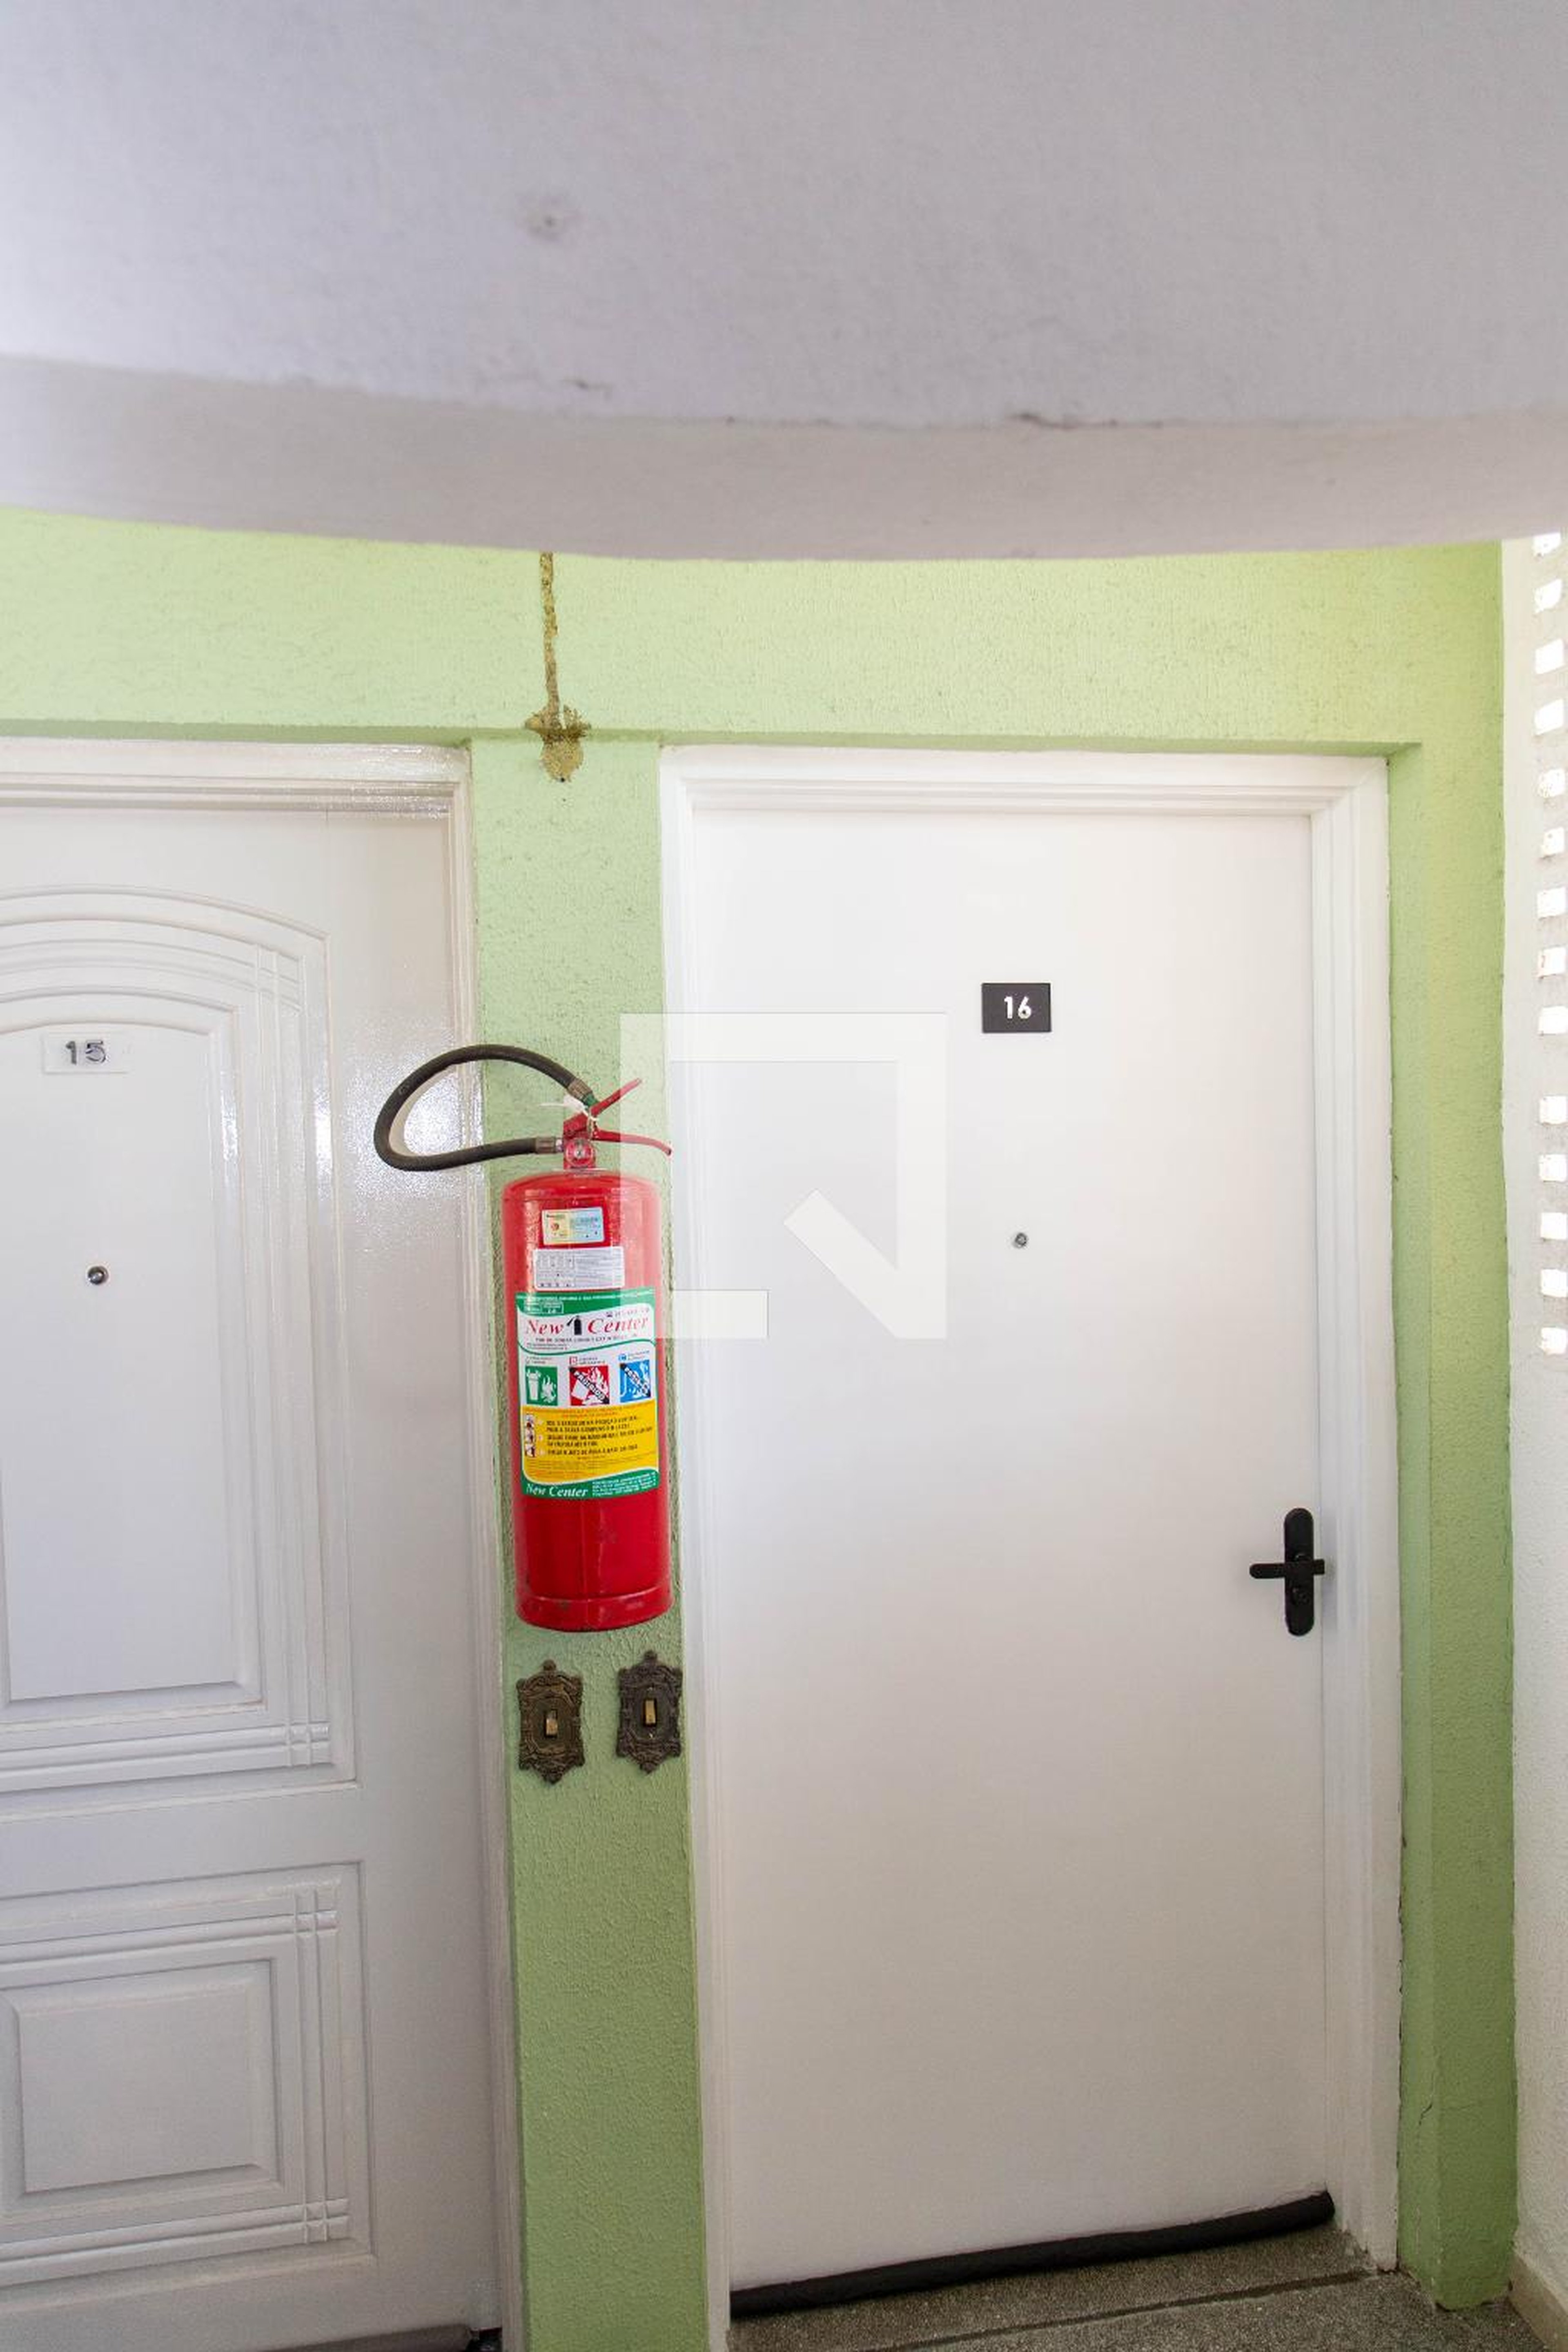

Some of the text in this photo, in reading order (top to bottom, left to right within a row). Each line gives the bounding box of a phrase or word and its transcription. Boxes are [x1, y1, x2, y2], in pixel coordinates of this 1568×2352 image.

[1004, 996, 1031, 1019] 16
[65, 1040, 106, 1065] 15
[526, 1316, 648, 1334] New Center
[526, 1483, 546, 1495] New
[549, 1484, 588, 1497] Center
